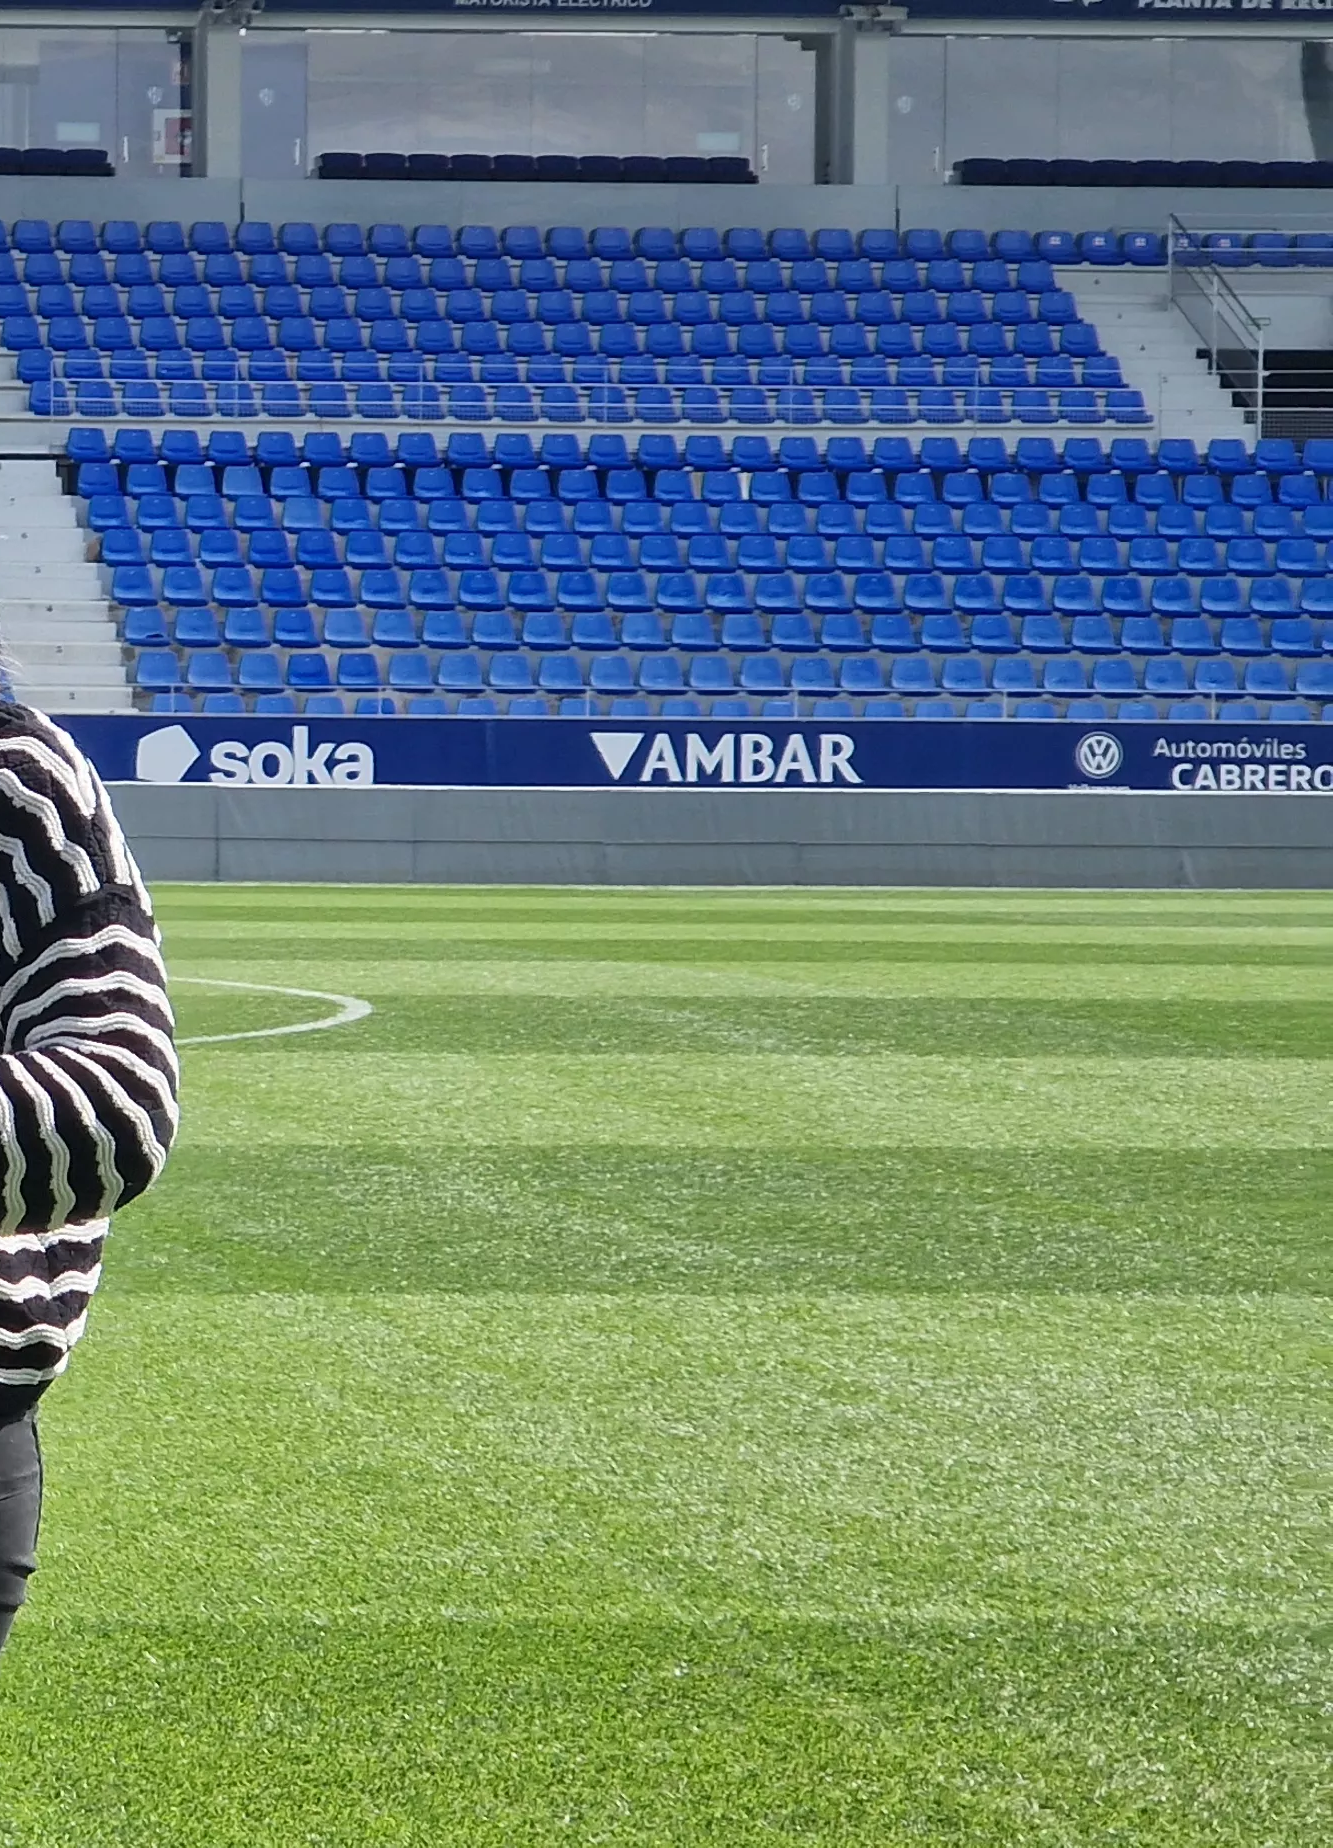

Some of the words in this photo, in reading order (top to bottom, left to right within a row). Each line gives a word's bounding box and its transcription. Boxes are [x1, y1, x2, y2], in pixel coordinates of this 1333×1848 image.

[209, 726, 374, 785] soka
[639, 733, 863, 784] AMBAR
[1153, 737, 1307, 760] Automóviles
